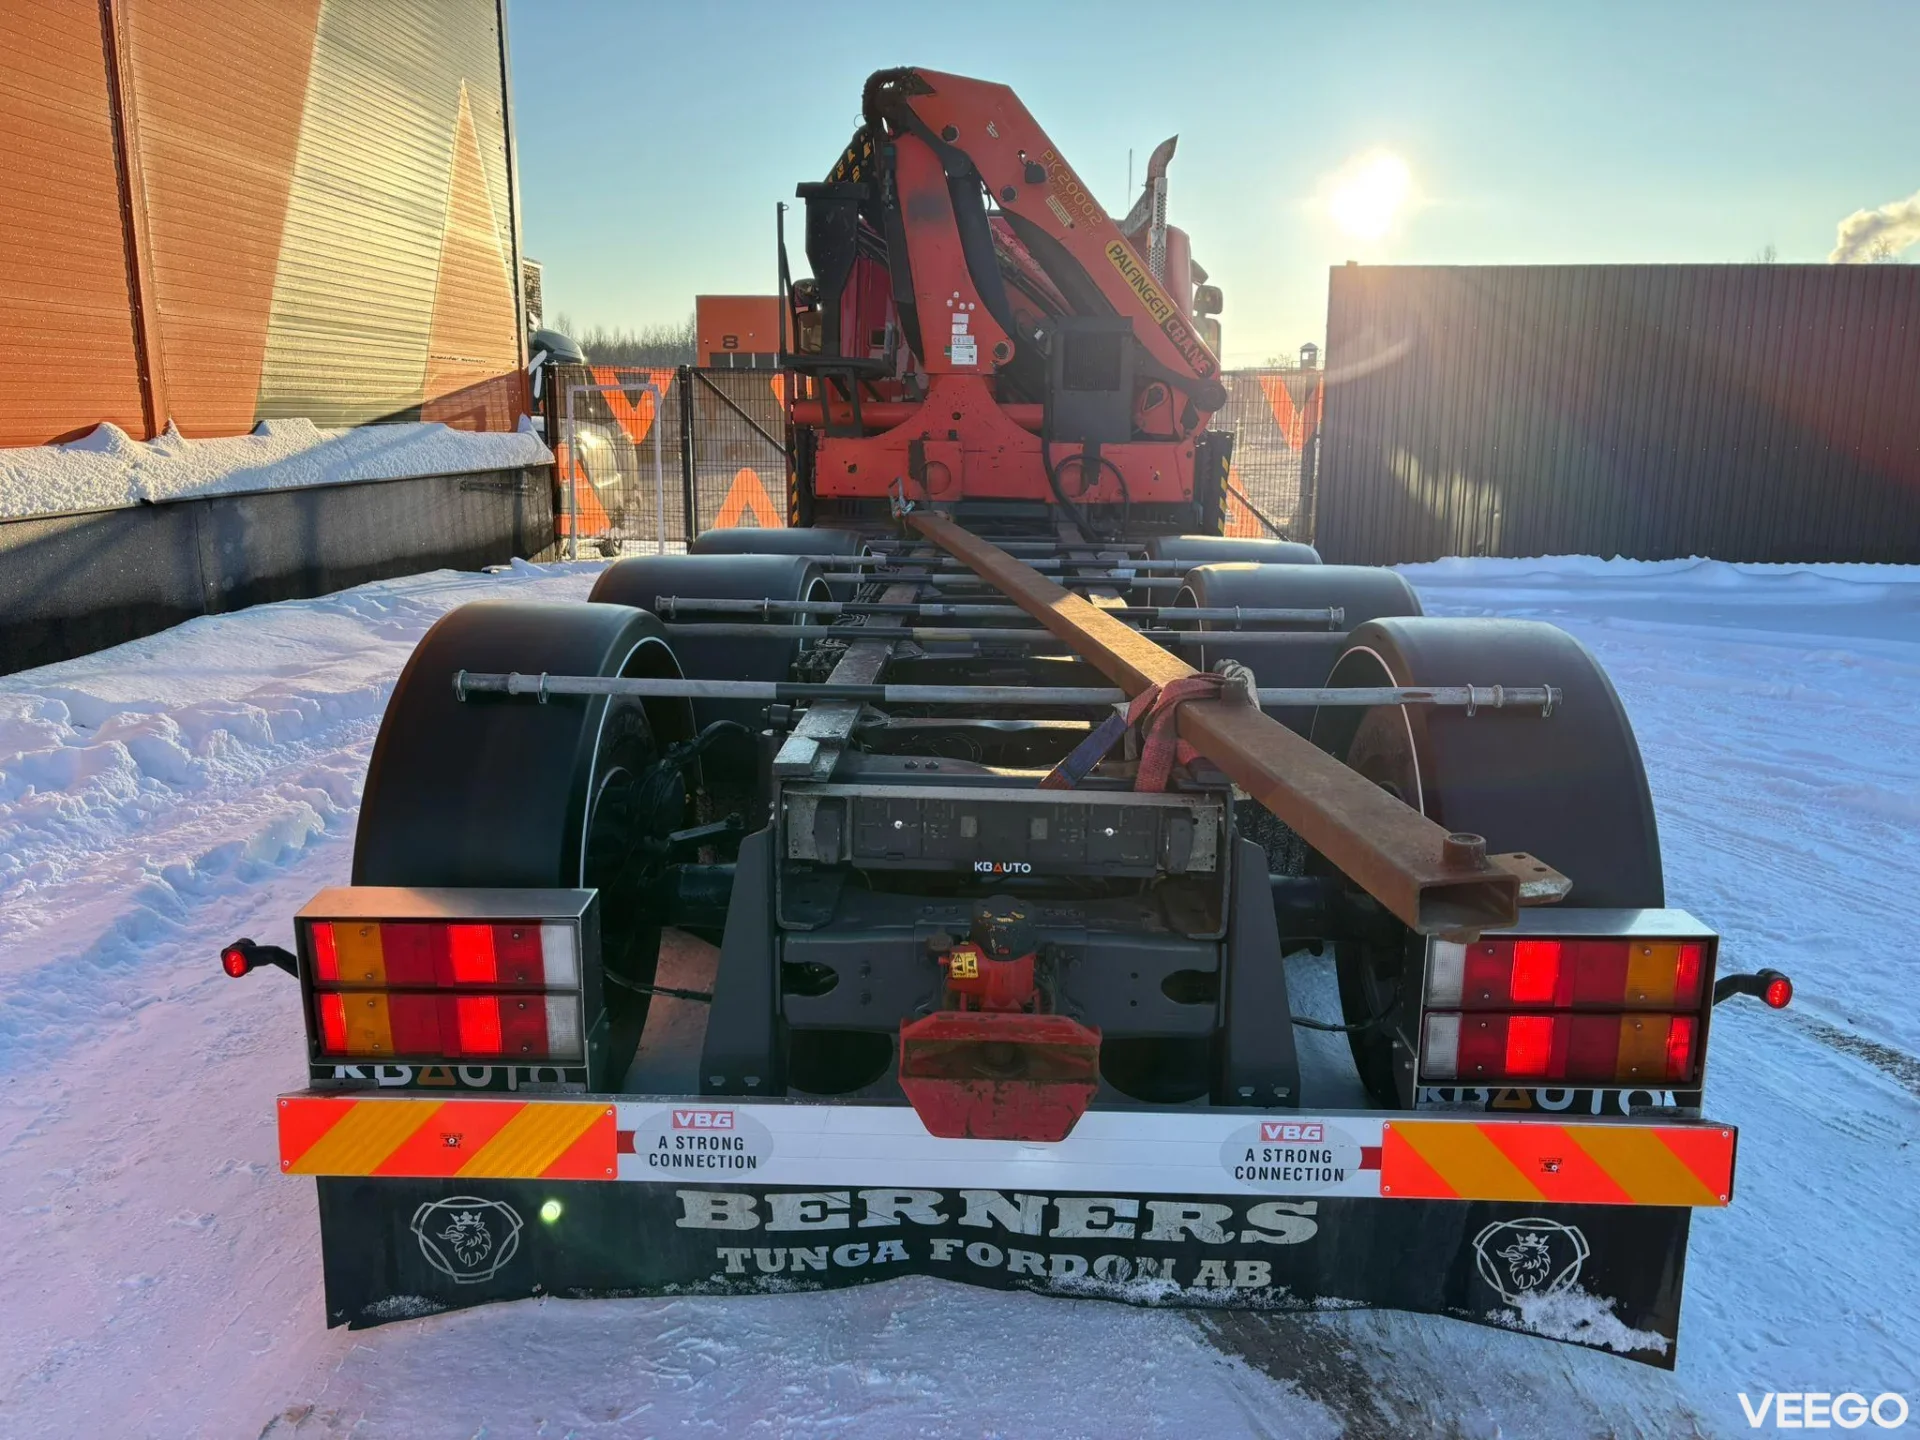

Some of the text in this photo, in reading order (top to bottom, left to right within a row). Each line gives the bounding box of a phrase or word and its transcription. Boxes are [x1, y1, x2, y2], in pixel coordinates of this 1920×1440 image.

[1041, 149, 1062, 173] PK
[1057, 170, 1103, 227] 20002
[1108, 244, 1170, 321] PALFINGER
[722, 335, 739, 349] 8
[974, 861, 1032, 873] KBAUTO
[675, 1112, 732, 1128] VBG
[1264, 1125, 1321, 1140] VBG
[658, 1135, 744, 1151] A STRONG
[649, 1153, 757, 1169] CONNECTION
[1245, 1148, 1332, 1163] A STRONG
[1234, 1165, 1344, 1182] CONNECTION
[676, 1189, 1318, 1245] BERNERS
[717, 1238, 1272, 1289] TUNGA FORDON AB
